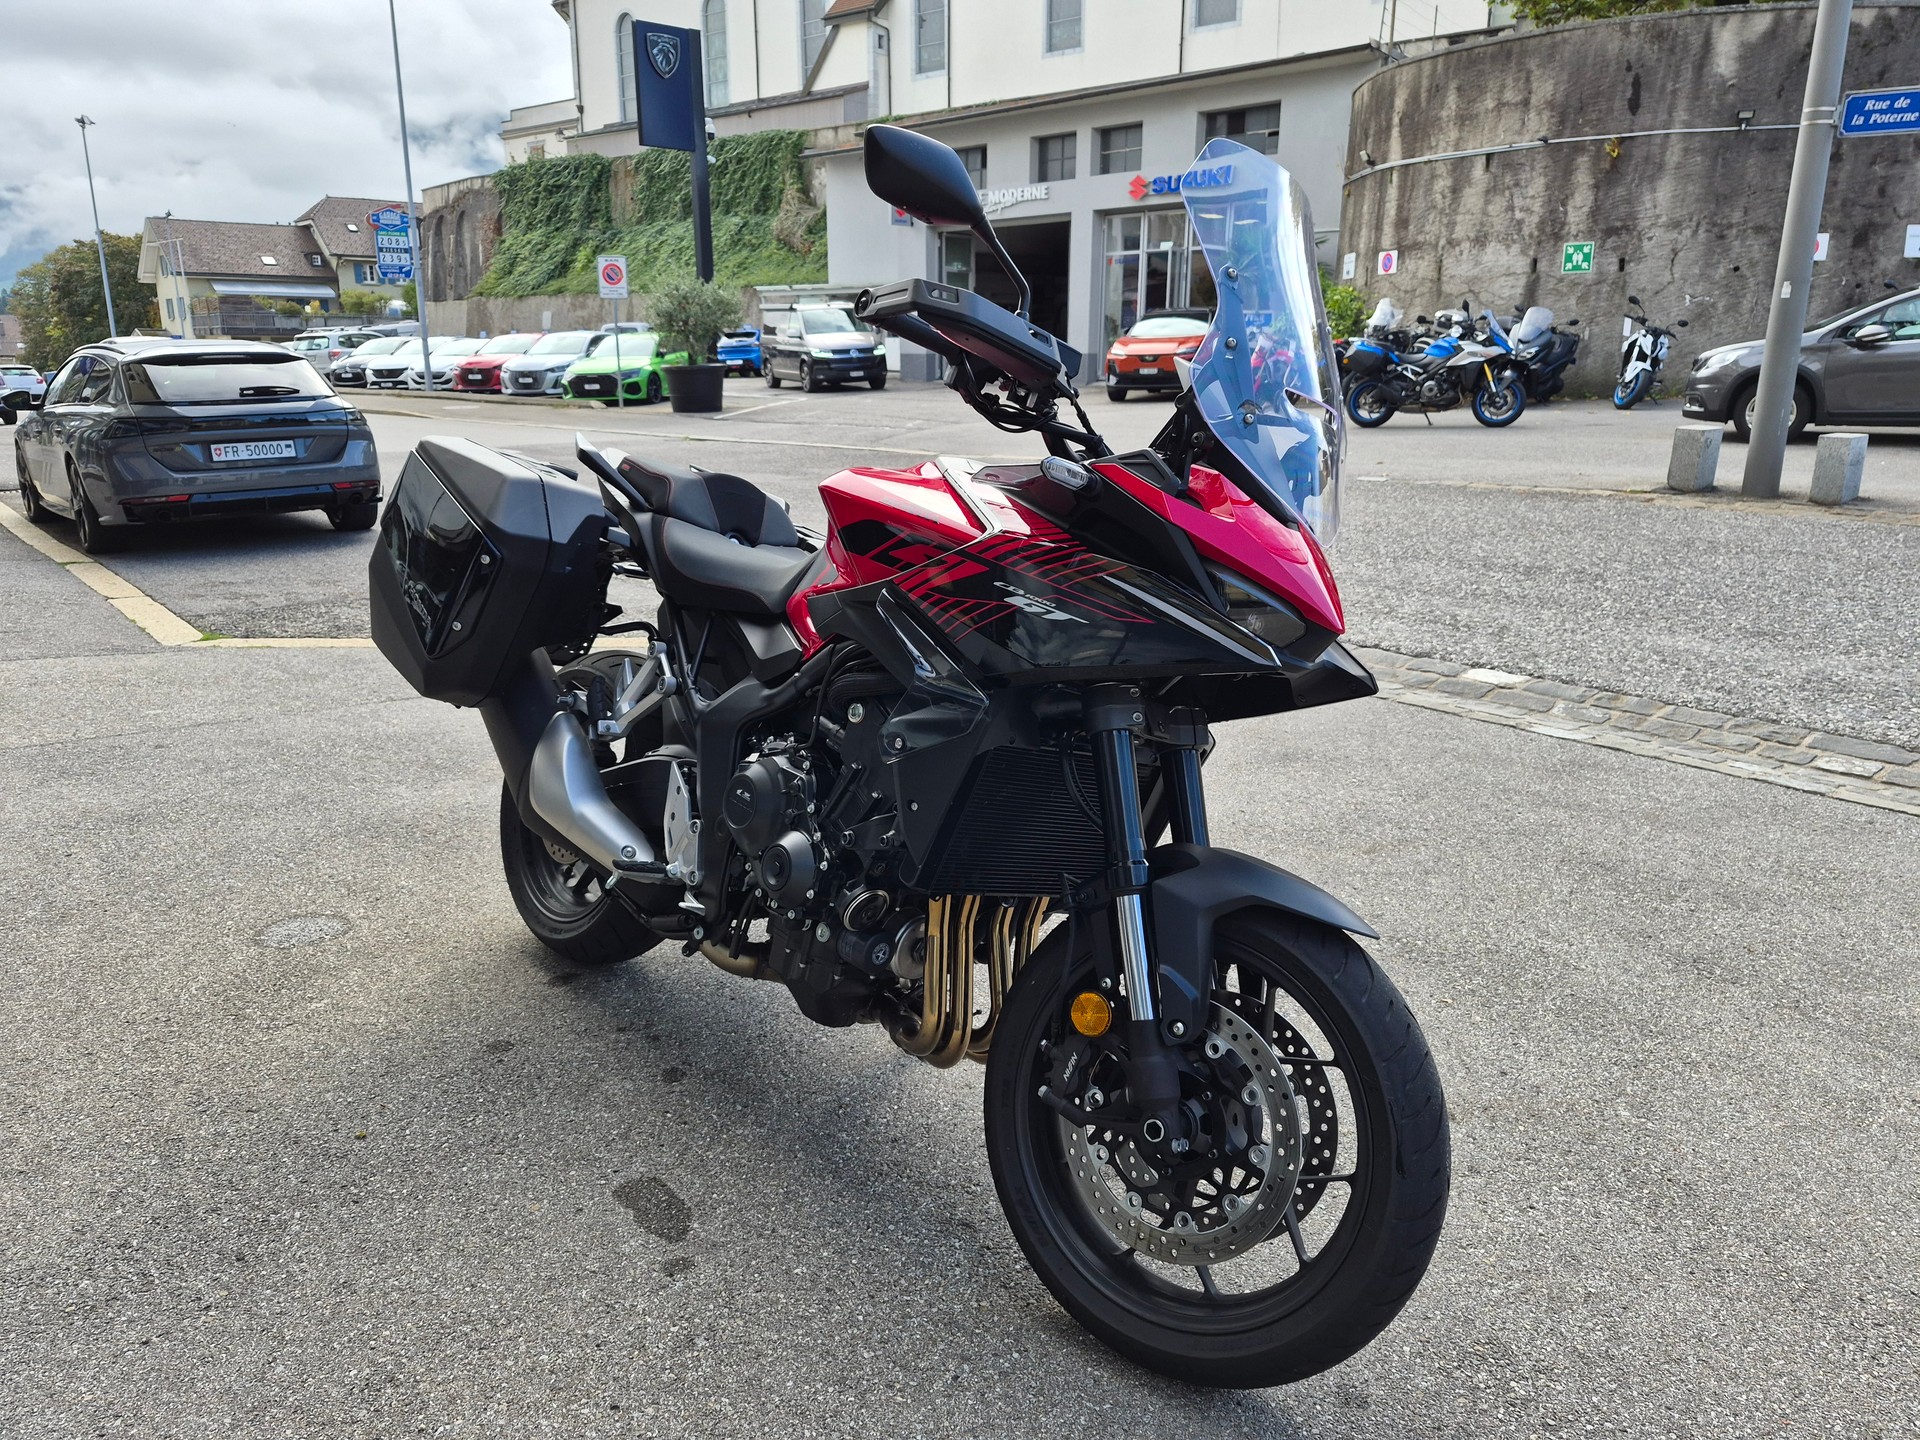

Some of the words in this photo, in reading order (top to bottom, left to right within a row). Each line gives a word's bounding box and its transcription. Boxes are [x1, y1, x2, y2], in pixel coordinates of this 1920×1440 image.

[1863, 99, 1891, 111] Rue
[1894, 96, 1911, 109] de
[1850, 113, 1865, 126] la
[1868, 111, 1920, 125] Poterne
[1152, 165, 1233, 194] SUZUKI
[988, 185, 1049, 204] MODERNE
[1003, 595, 1090, 624] GT
